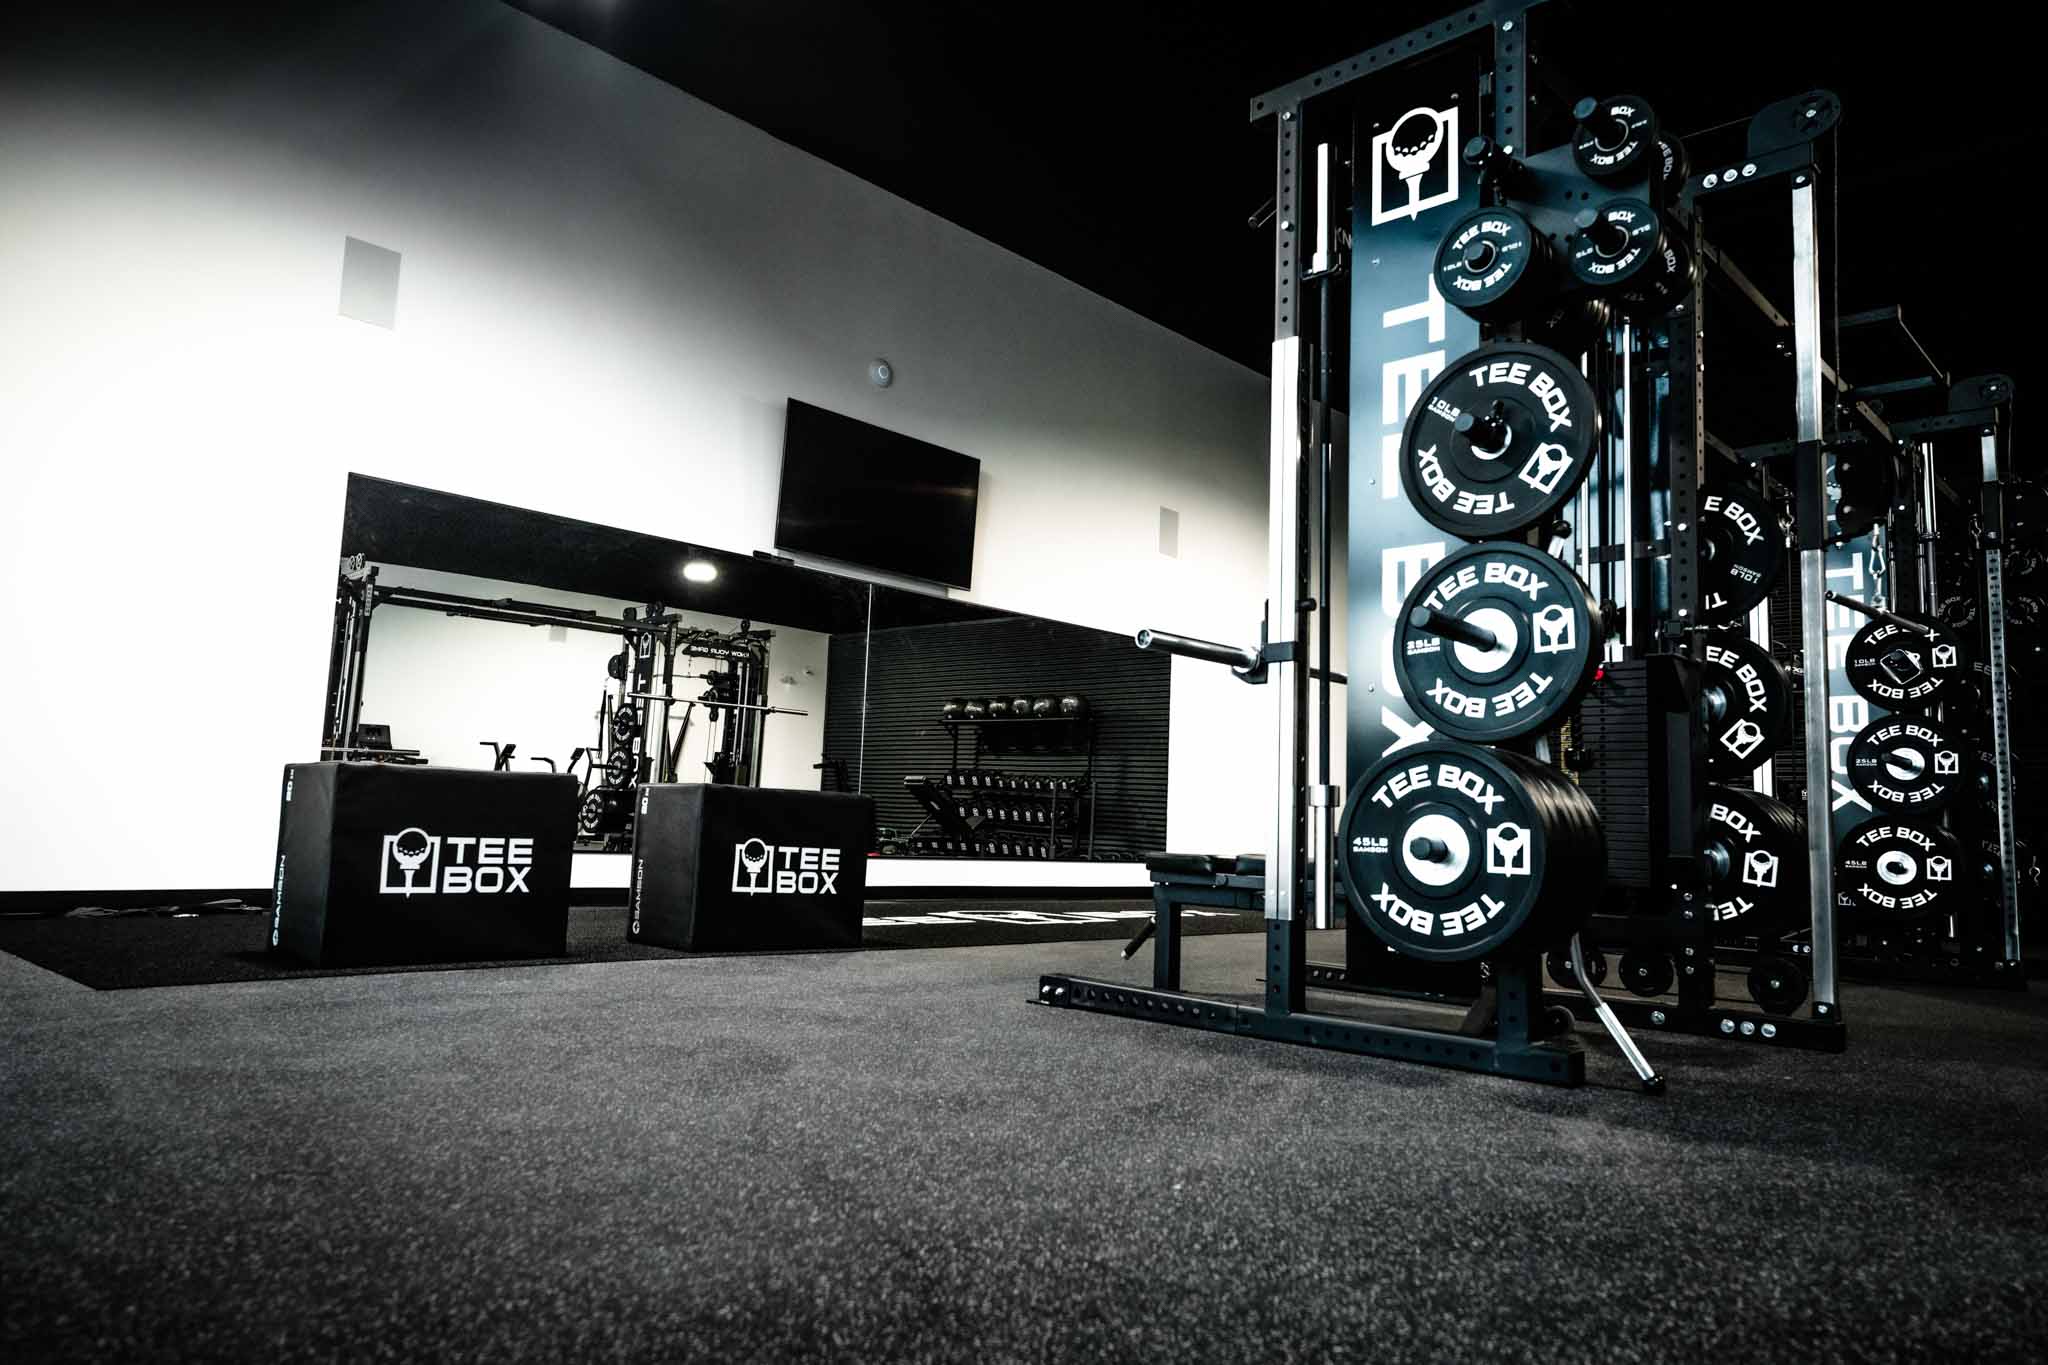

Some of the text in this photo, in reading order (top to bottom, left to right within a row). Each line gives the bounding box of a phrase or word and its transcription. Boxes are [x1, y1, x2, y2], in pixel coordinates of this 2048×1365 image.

[1610, 106, 1636, 118] BOX
[1608, 210, 1636, 223] BOX
[1452, 220, 1512, 250] TEE BOX
[1588, 247, 1641, 274] TEE BOX
[1452, 262, 1512, 291] TEE BOX
[1431, 396, 1461, 417] 10LB
[1469, 362, 1573, 432] TEE BOX
[1418, 444, 1515, 515] TEE BOX
[1723, 502, 1765, 546] BOX
[1423, 562, 1549, 611] TEE BOX
[1729, 568, 1759, 584] 10LB
[1863, 624, 1899, 646] TEE
[1705, 645, 1740, 669] EE
[1736, 663, 1768, 713] BOX
[1867, 676, 1944, 700] TEE BOX
[1426, 671, 1554, 719] TEE BOX
[1866, 724, 1944, 748] TEE BOX
[1371, 764, 1505, 815] TEE BOX
[1867, 779, 1945, 803] TEE BOX
[1709, 803, 1762, 844] BOX
[446, 837, 534, 865] TEE
[1352, 836, 1389, 847] 45LB
[1855, 826, 1936, 852] TEE BOX
[778, 846, 841, 871] TEE
[274, 855, 286, 929] SAMSON
[442, 866, 532, 894] BOX
[634, 859, 644, 920] SAMSON
[776, 871, 839, 895] BOX
[1371, 882, 1505, 937] TEE BOX
[1856, 882, 1939, 909] TEE BOX
